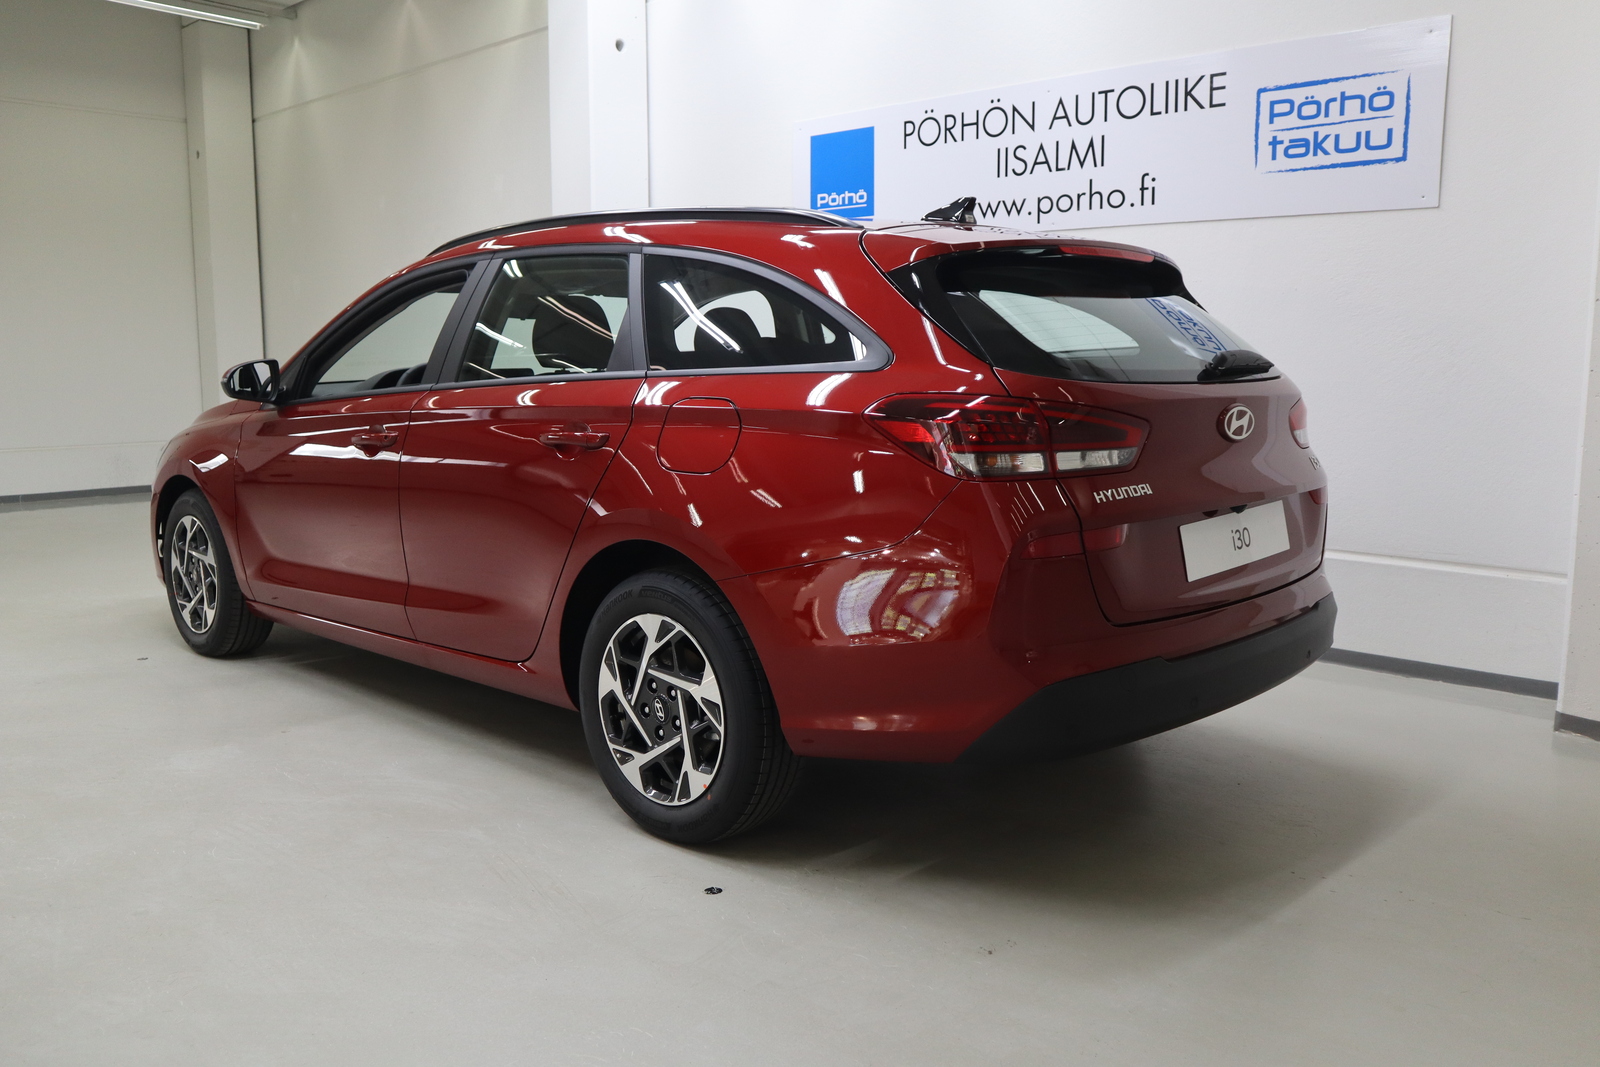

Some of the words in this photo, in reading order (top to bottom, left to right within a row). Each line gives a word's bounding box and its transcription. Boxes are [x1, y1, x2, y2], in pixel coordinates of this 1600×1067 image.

[904, 98, 1036, 150] PÖRHÖN
[1049, 71, 1227, 130] AUTOLIIKE
[1268, 85, 1395, 125] Pörhö
[997, 134, 1106, 179] IISALMI
[1268, 127, 1393, 161] takuu
[816, 188, 868, 208] Pörhö
[976, 173, 1156, 225] ww.porho.fi
[1093, 483, 1153, 504] HYUNDAI
[1231, 526, 1252, 551] i30
